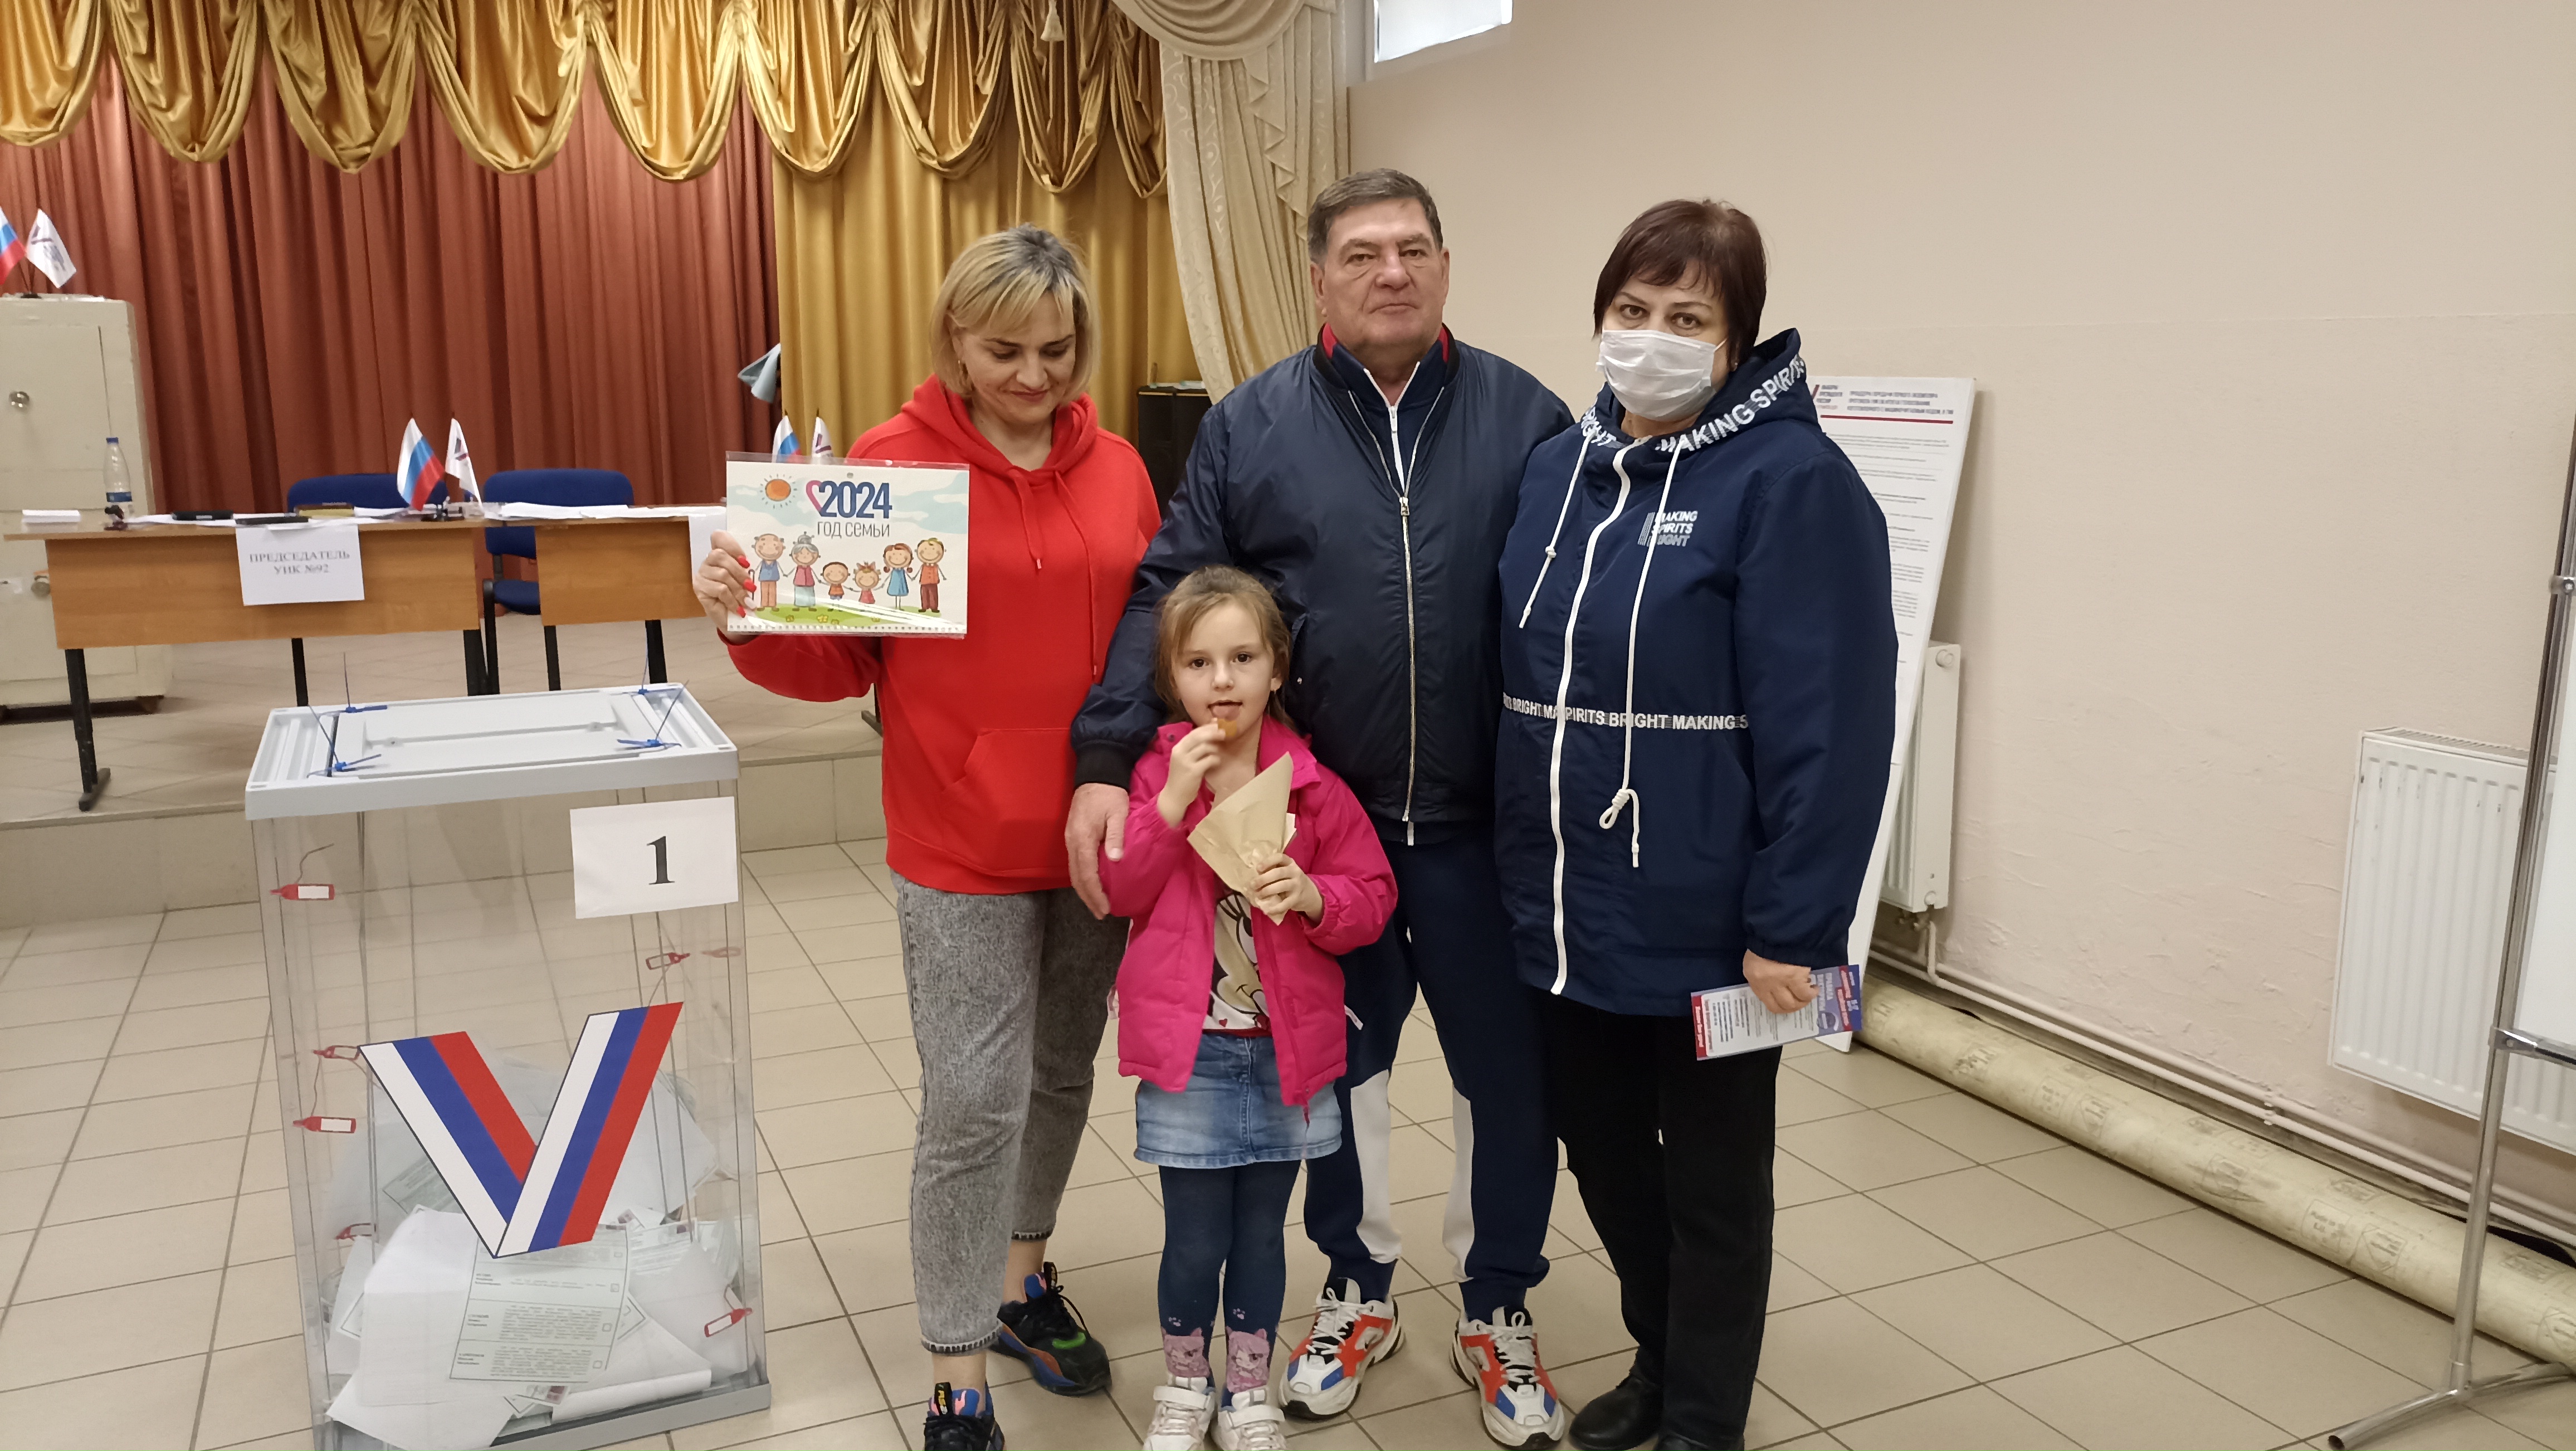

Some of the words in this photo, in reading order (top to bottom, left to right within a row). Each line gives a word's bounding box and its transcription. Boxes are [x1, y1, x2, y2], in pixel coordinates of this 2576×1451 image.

[818, 480, 892, 519] 2024
[1651, 523, 1694, 534] PIRITS
[250, 549, 350, 563] ПРЕДСЕДАТЕЛЬ
[1513, 698, 1542, 717] BRIGHT
[1672, 715, 1735, 730] MAKING
[646, 835, 675, 885] 1
